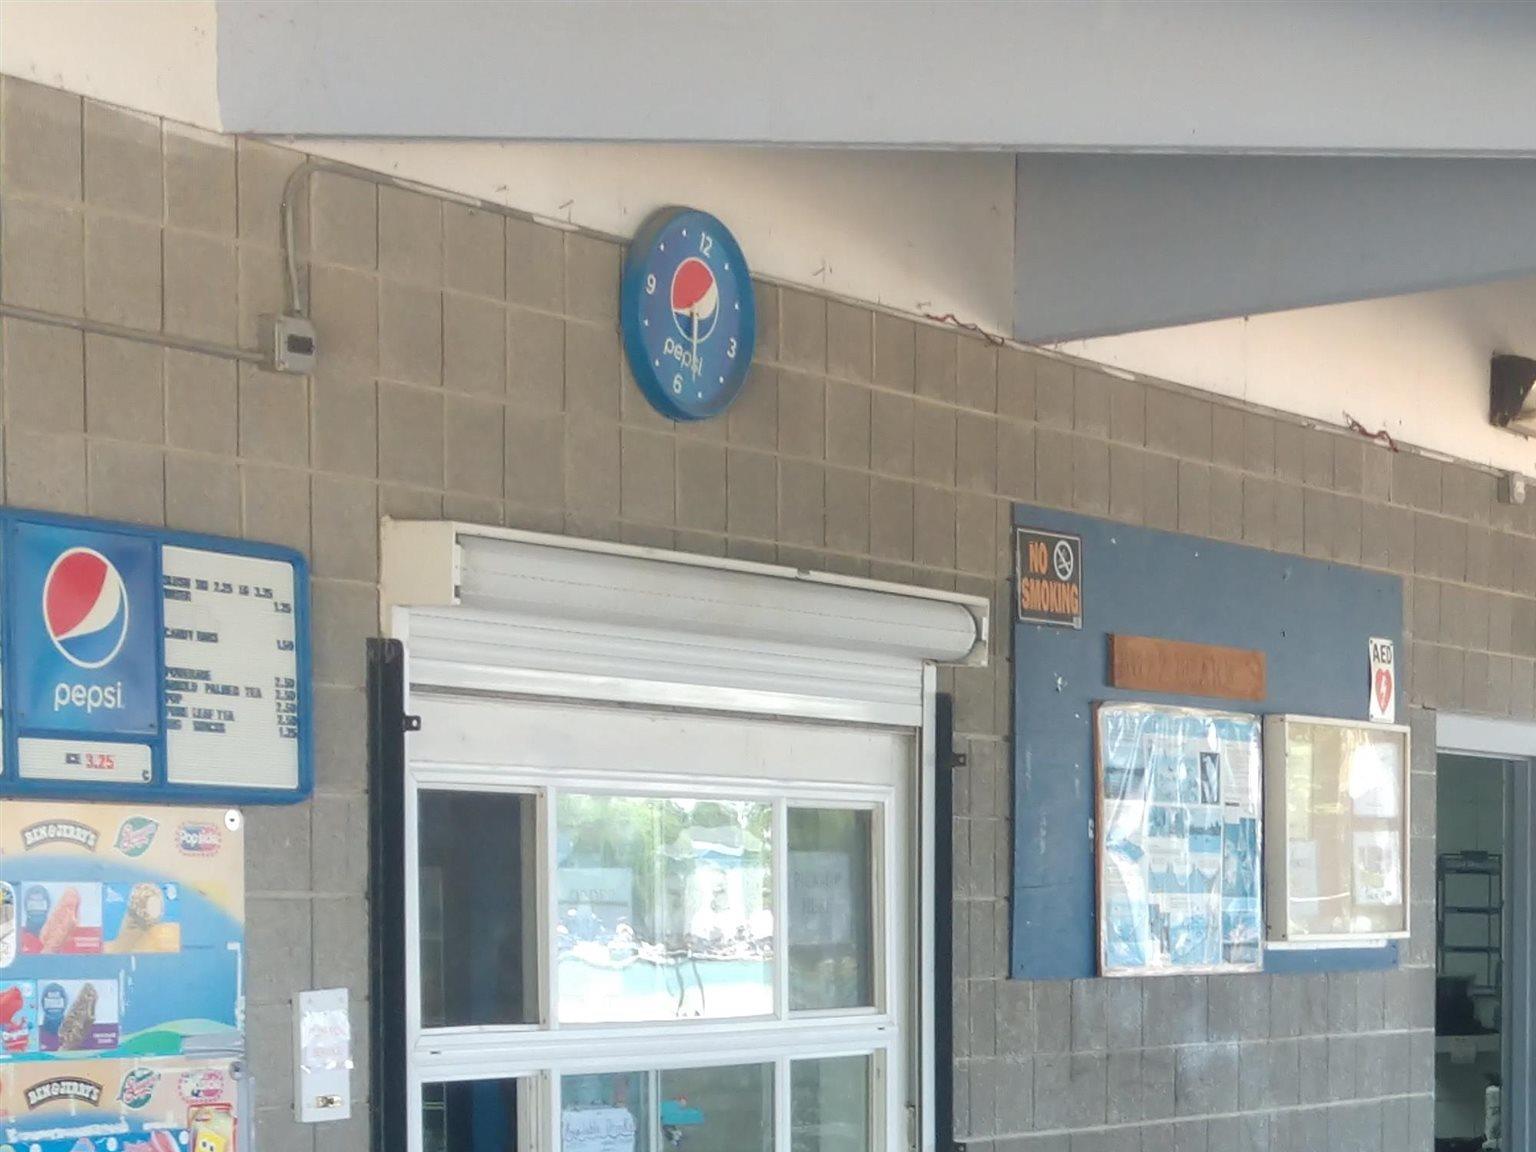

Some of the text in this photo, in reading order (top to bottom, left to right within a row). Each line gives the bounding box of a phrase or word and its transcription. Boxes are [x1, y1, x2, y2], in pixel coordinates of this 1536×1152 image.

[699, 232, 713, 258] 12
[646, 273, 656, 295] 9
[727, 338, 737, 358] 3
[672, 374, 683, 394] 6
[1028, 540, 1049, 575] NO
[1021, 576, 1079, 615] SMOKING
[1372, 643, 1393, 664] AED
[54, 681, 123, 713] pepsi
